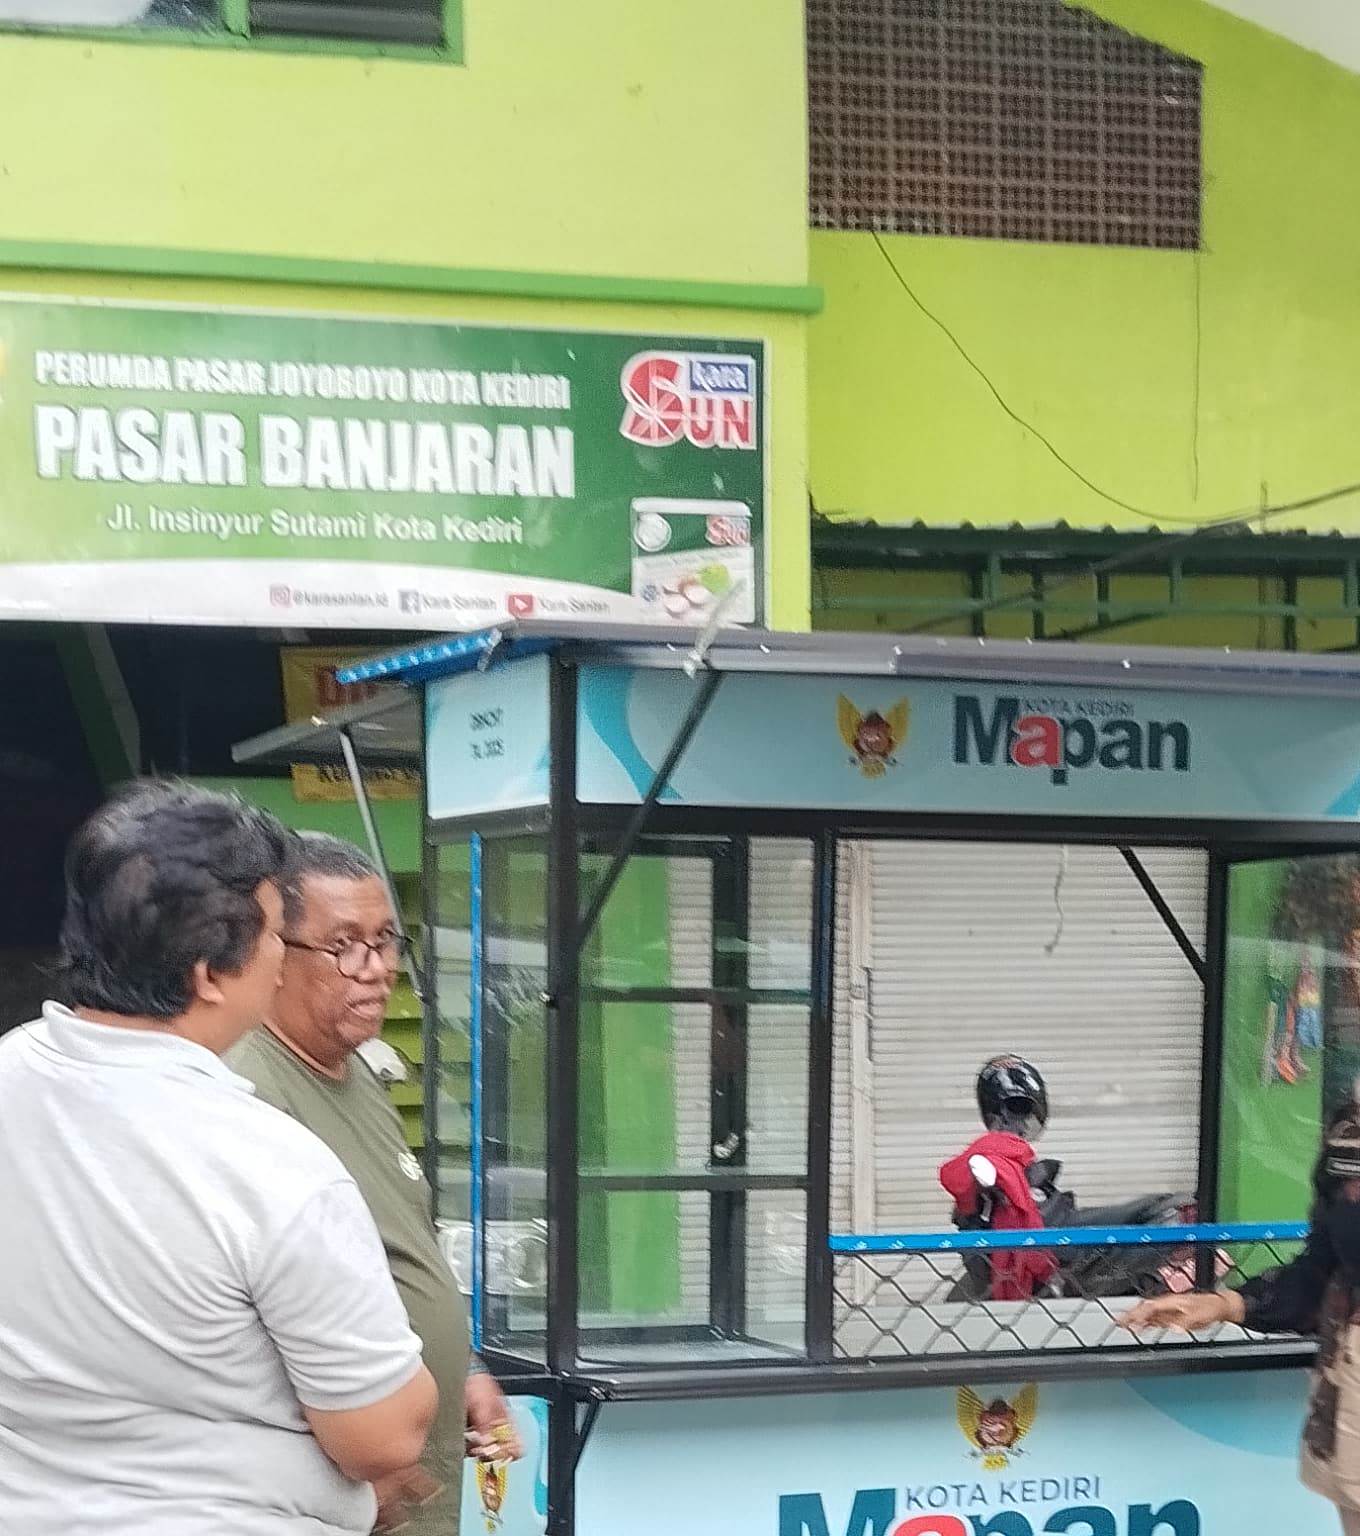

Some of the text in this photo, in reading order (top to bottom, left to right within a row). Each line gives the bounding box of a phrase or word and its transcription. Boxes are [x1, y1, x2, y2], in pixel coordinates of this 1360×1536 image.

[35, 350, 571, 409] PERUMDA PASAR JOYOBOYO KOTA KEDIRI
[34, 403, 576, 498] PASAR BANJARAN
[107, 503, 523, 544] Jl. Insinyur Sutami Kota Kediri
[953, 694, 1192, 786] Mapan
[905, 1475, 1101, 1510] KOTA KEDIRI
